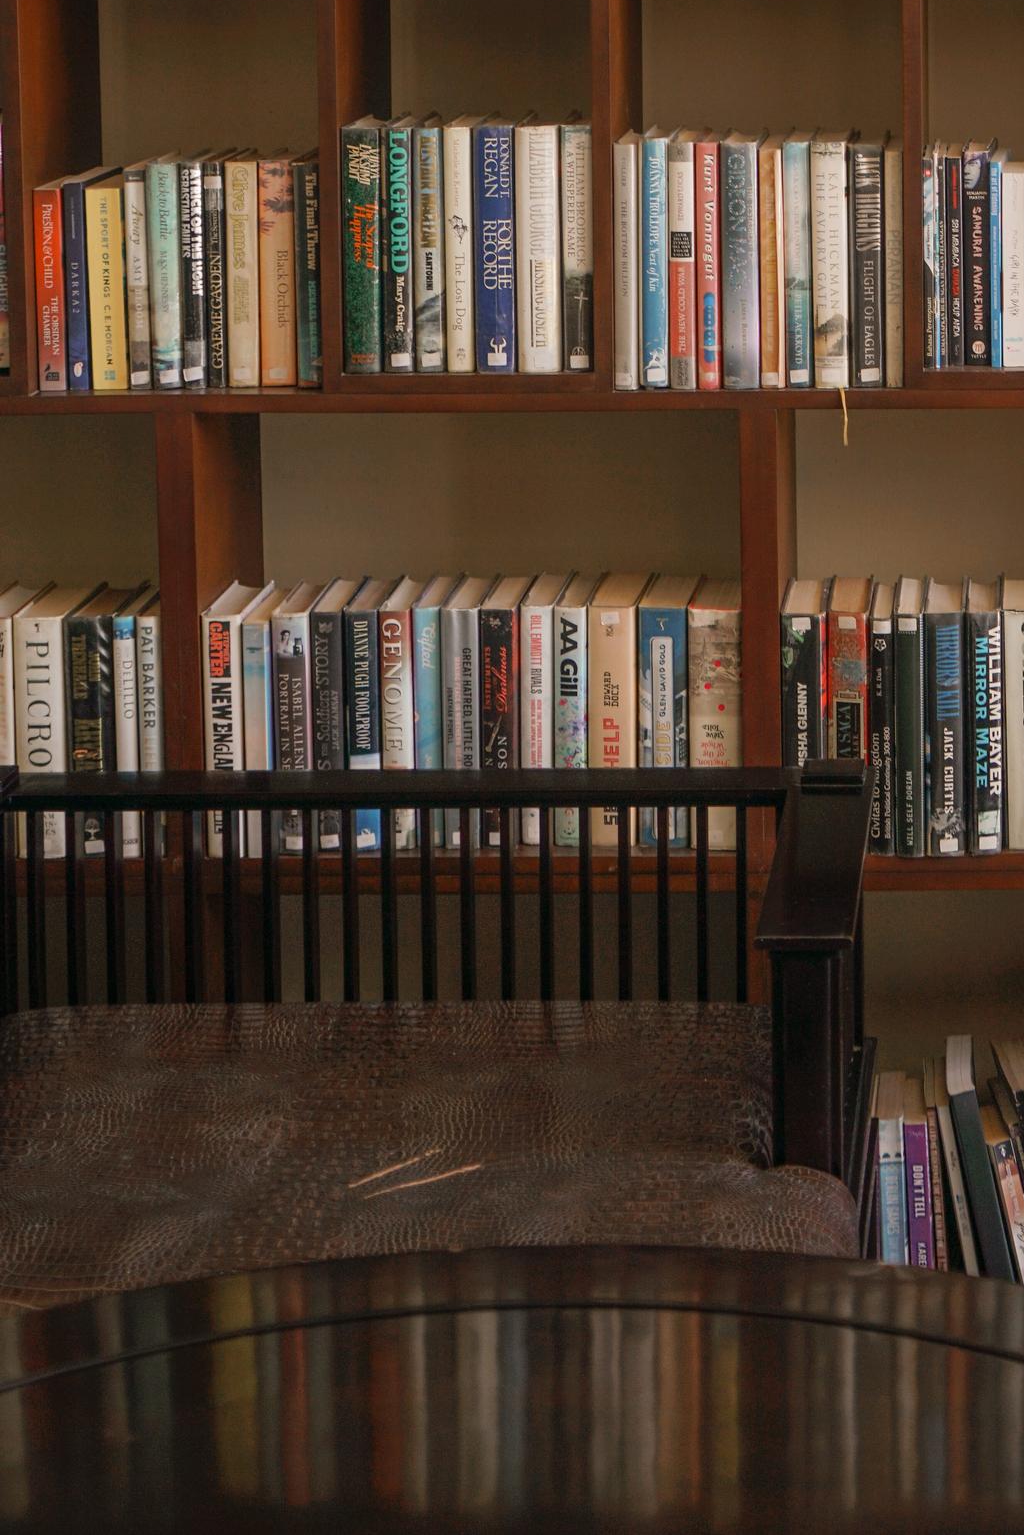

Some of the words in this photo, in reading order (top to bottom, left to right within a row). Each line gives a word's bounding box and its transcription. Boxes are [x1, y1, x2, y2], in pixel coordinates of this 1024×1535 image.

[484, 138, 497, 197] REGAN
[500, 138, 509, 185] DONALD
[576, 141, 584, 195] WILLIAM
[704, 154, 714, 193] Kurt
[856, 154, 880, 187] JACK
[306, 174, 316, 196] The
[389, 131, 408, 273] LONGFORD
[500, 188, 509, 198] T.
[567, 161, 575, 222] WHISPERED
[42, 204, 52, 245] PRESTON
[306, 200, 316, 229] Final
[856, 193, 881, 251] HIGGINS
[972, 206, 982, 257] SAMURAI
[308, 231, 316, 270] Throw
[498, 219, 511, 253] FOR
[577, 201, 585, 267] BRODRICK
[703, 201, 714, 281] Vonnegut
[43, 256, 54, 288] CHILD
[278, 250, 288, 280] Black
[425, 252, 433, 290] SANTORINI
[455, 253, 466, 275] The
[483, 221, 497, 289] RECORD
[498, 254, 511, 289] THE
[394, 276, 405, 303] Mary
[456, 280, 465, 304] Lost
[864, 261, 873, 302] FLIGHT
[973, 265, 984, 330] AWAKENING
[278, 283, 289, 327] Orchids
[396, 305, 405, 331] Craig
[454, 308, 465, 330] Dog
[865, 306, 874, 321] OF
[43, 306, 51, 345] CHAMBER
[52, 316, 60, 354] OBSIDIAN
[865, 325, 874, 365] EAGLES
[141, 627, 152, 655] PAT
[353, 621, 368, 657] DIANNE
[531, 615, 542, 630] BILL
[560, 617, 577, 654] AA
[531, 633, 542, 665] EMMOTT
[354, 661, 369, 687] PUGH
[382, 619, 403, 751] GENOME
[531, 668, 542, 693] RIVALS
[561, 659, 577, 696] Gill
[975, 638, 987, 719] MIRROR
[988, 626, 1000, 720] WILLIAM
[143, 664, 155, 728] BARKER
[356, 691, 370, 749] FOOLPROOF
[943, 727, 953, 759] JACK
[976, 728, 988, 787] MAZE
[989, 726, 1000, 795] BAYER
[943, 766, 954, 813] CURTIS
[913, 1165, 924, 1194] DON'T
[915, 1197, 925, 1217] TELL
